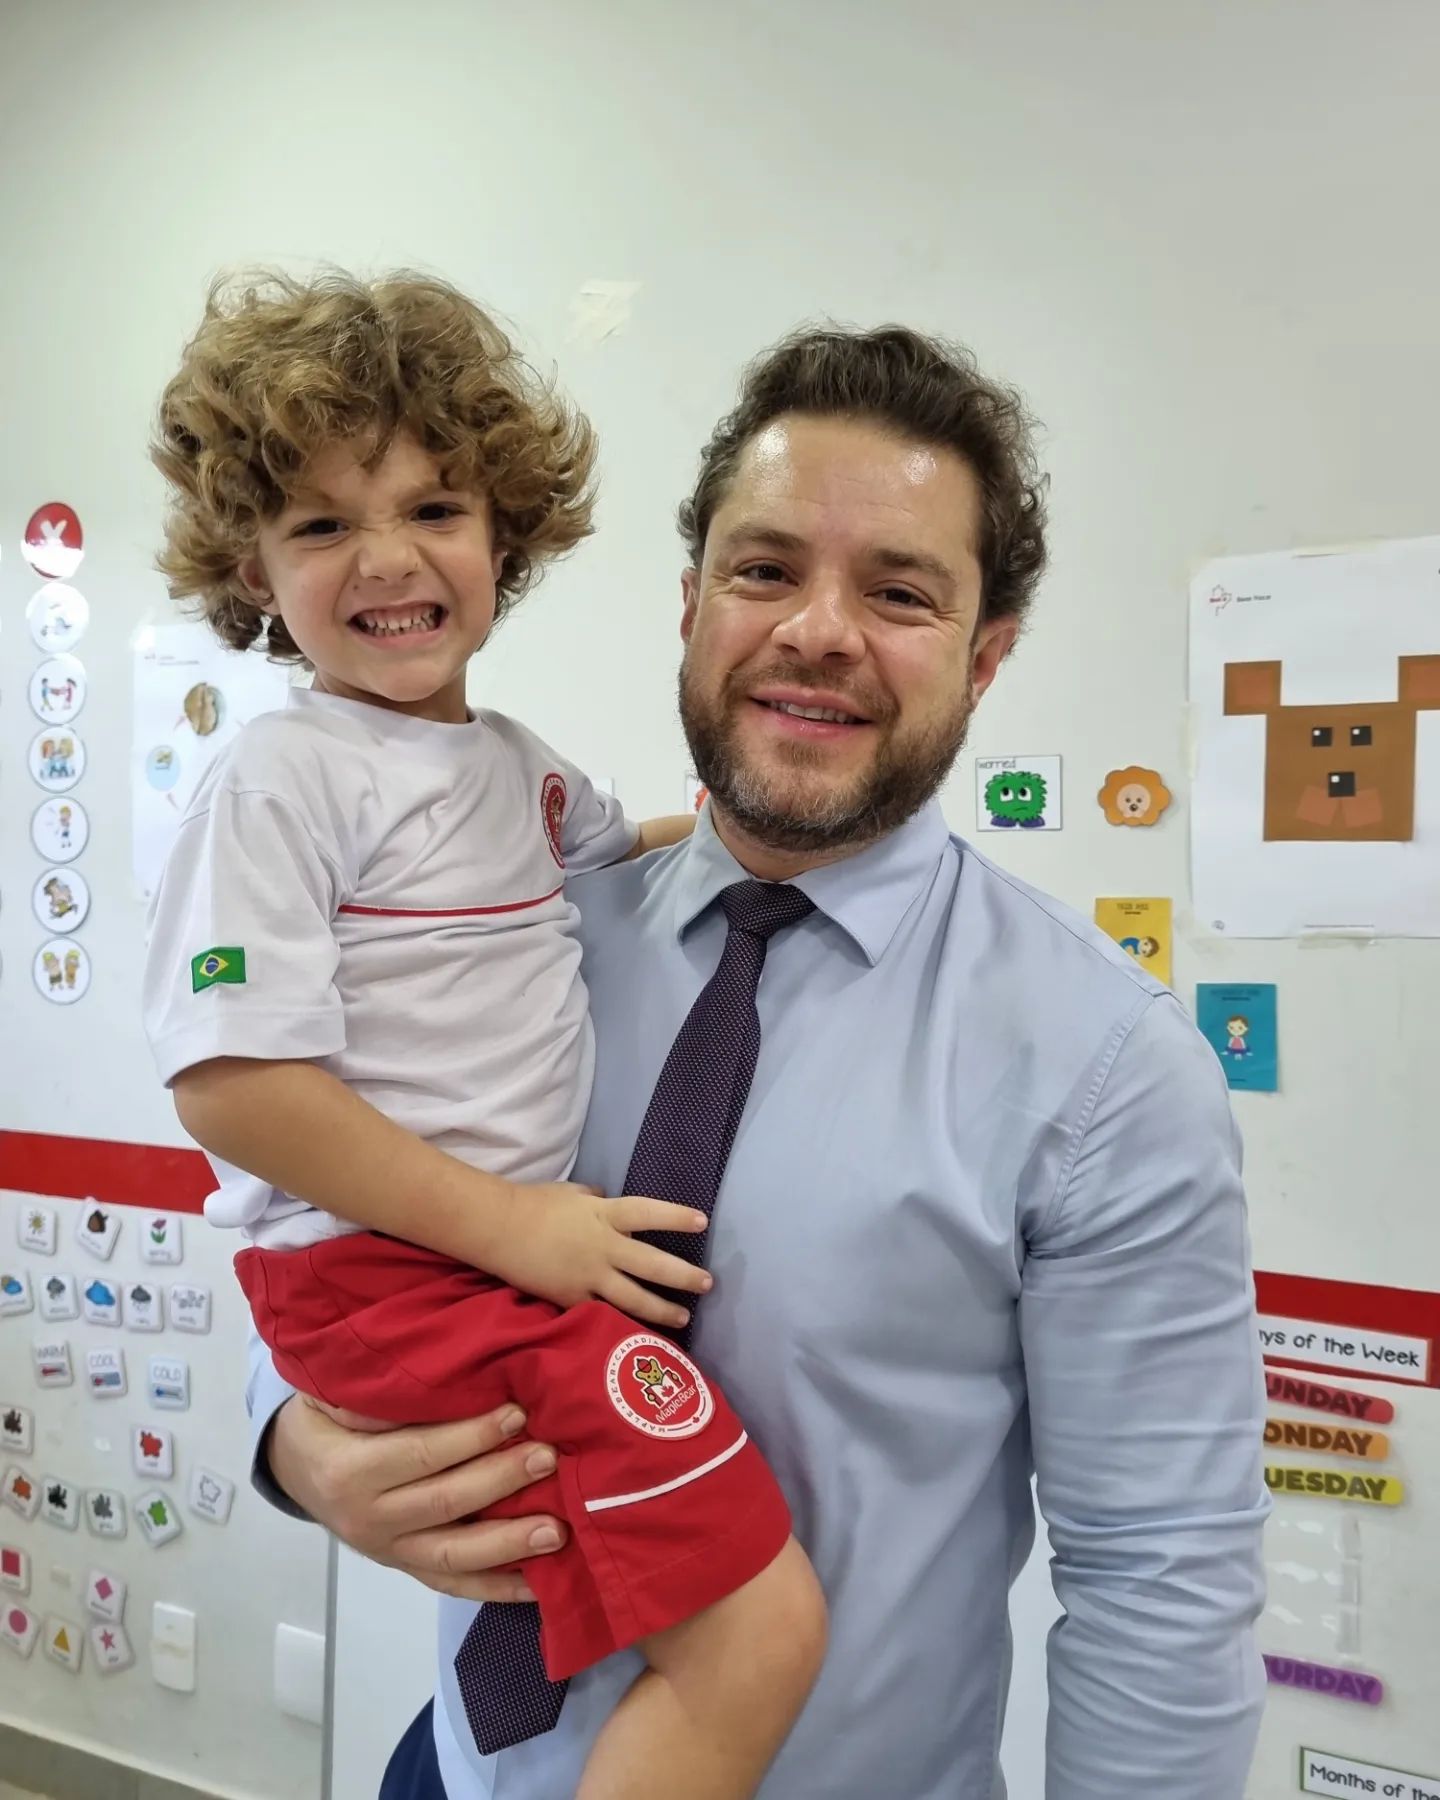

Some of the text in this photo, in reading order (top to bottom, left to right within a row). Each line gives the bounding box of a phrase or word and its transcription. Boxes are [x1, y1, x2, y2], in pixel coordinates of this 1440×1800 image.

[1293, 1333, 1317, 1349] of
[1324, 1337, 1355, 1355] the
[1361, 1342, 1420, 1368] Week
[152, 1365, 182, 1381] COLD
[608, 1369, 623, 1404] BEAR
[1265, 1373, 1372, 1418] UNDAY
[1263, 1420, 1373, 1456] ONDAY
[1263, 1467, 1387, 1501] UESDAY
[1268, 1656, 1376, 1703] URDAY
[1309, 1763, 1376, 1793] Months
[1383, 1783, 1405, 1798] of
